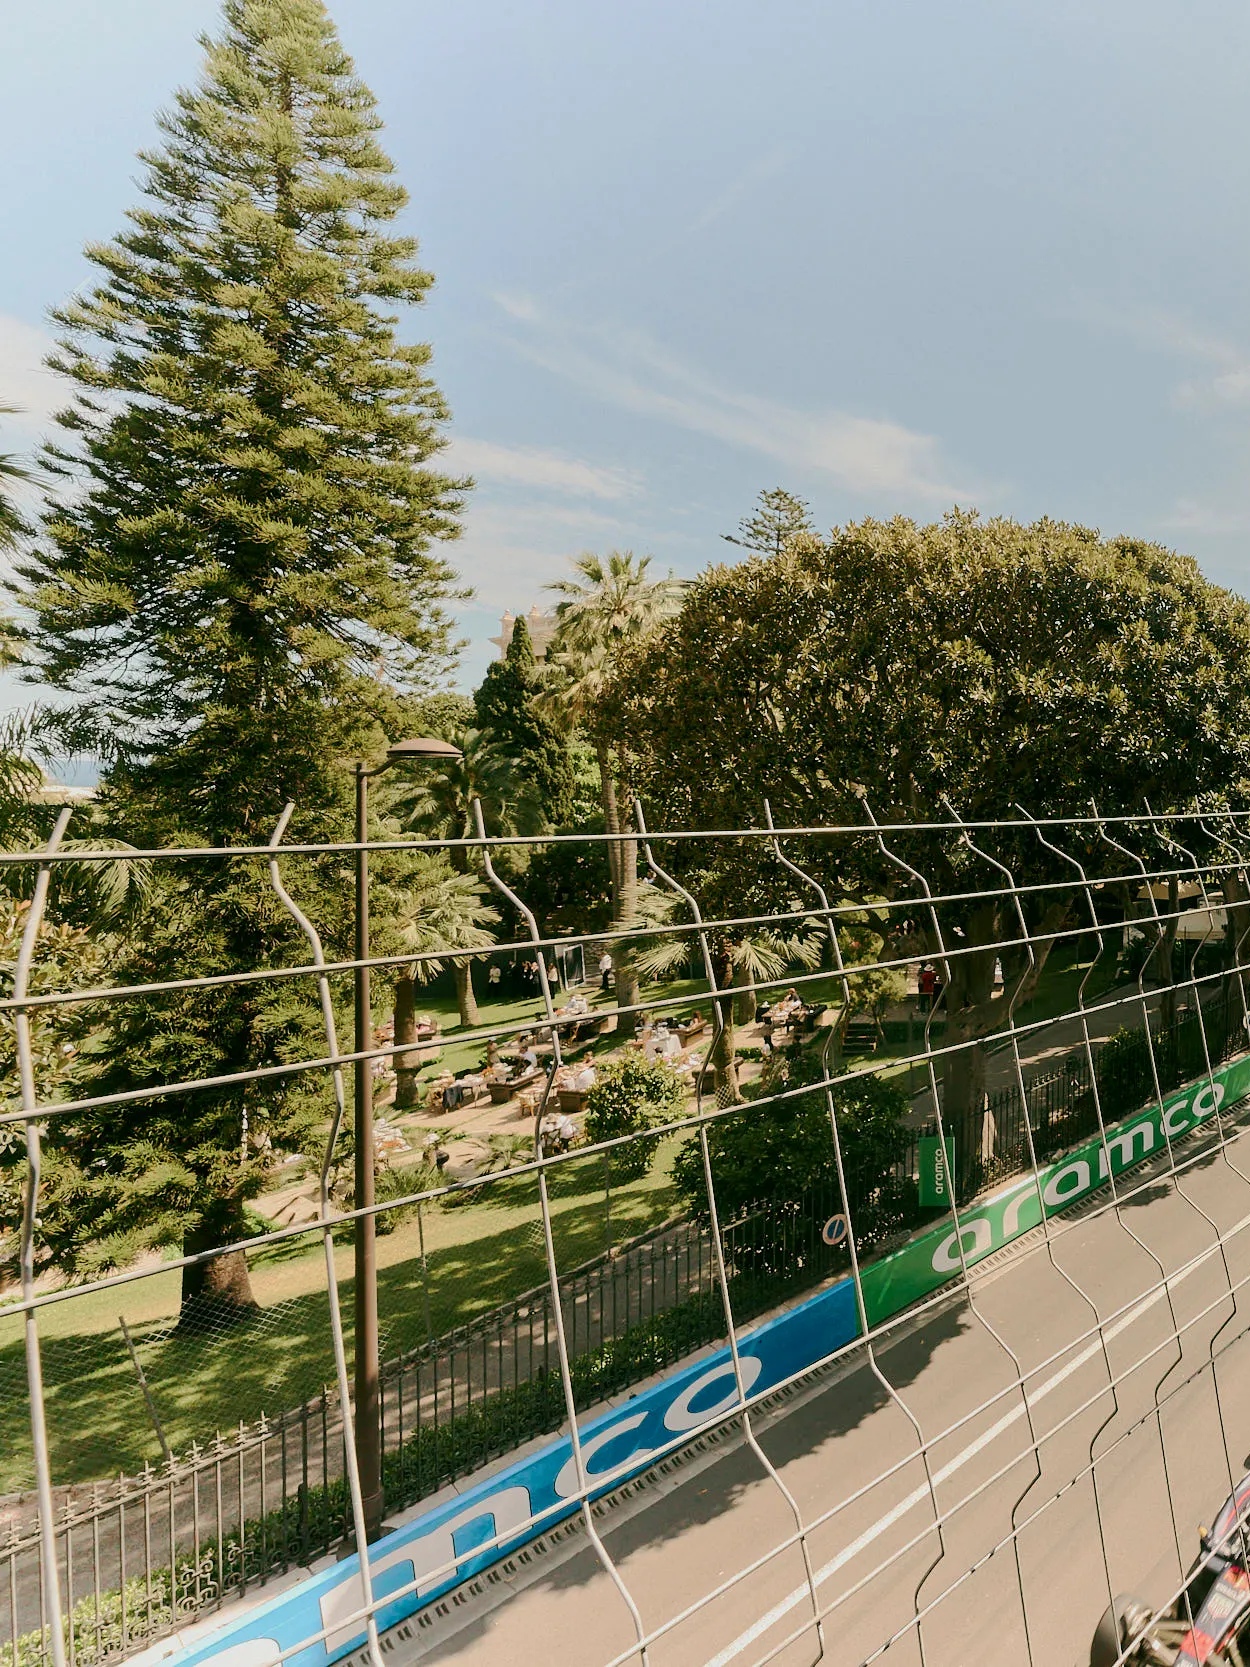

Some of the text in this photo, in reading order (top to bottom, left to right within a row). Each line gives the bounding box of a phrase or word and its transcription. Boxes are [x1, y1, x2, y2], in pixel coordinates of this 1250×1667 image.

[931, 1083, 1225, 1273] aramco
[935, 1149, 943, 1195] aramco
[191, 1356, 763, 1667] mco
